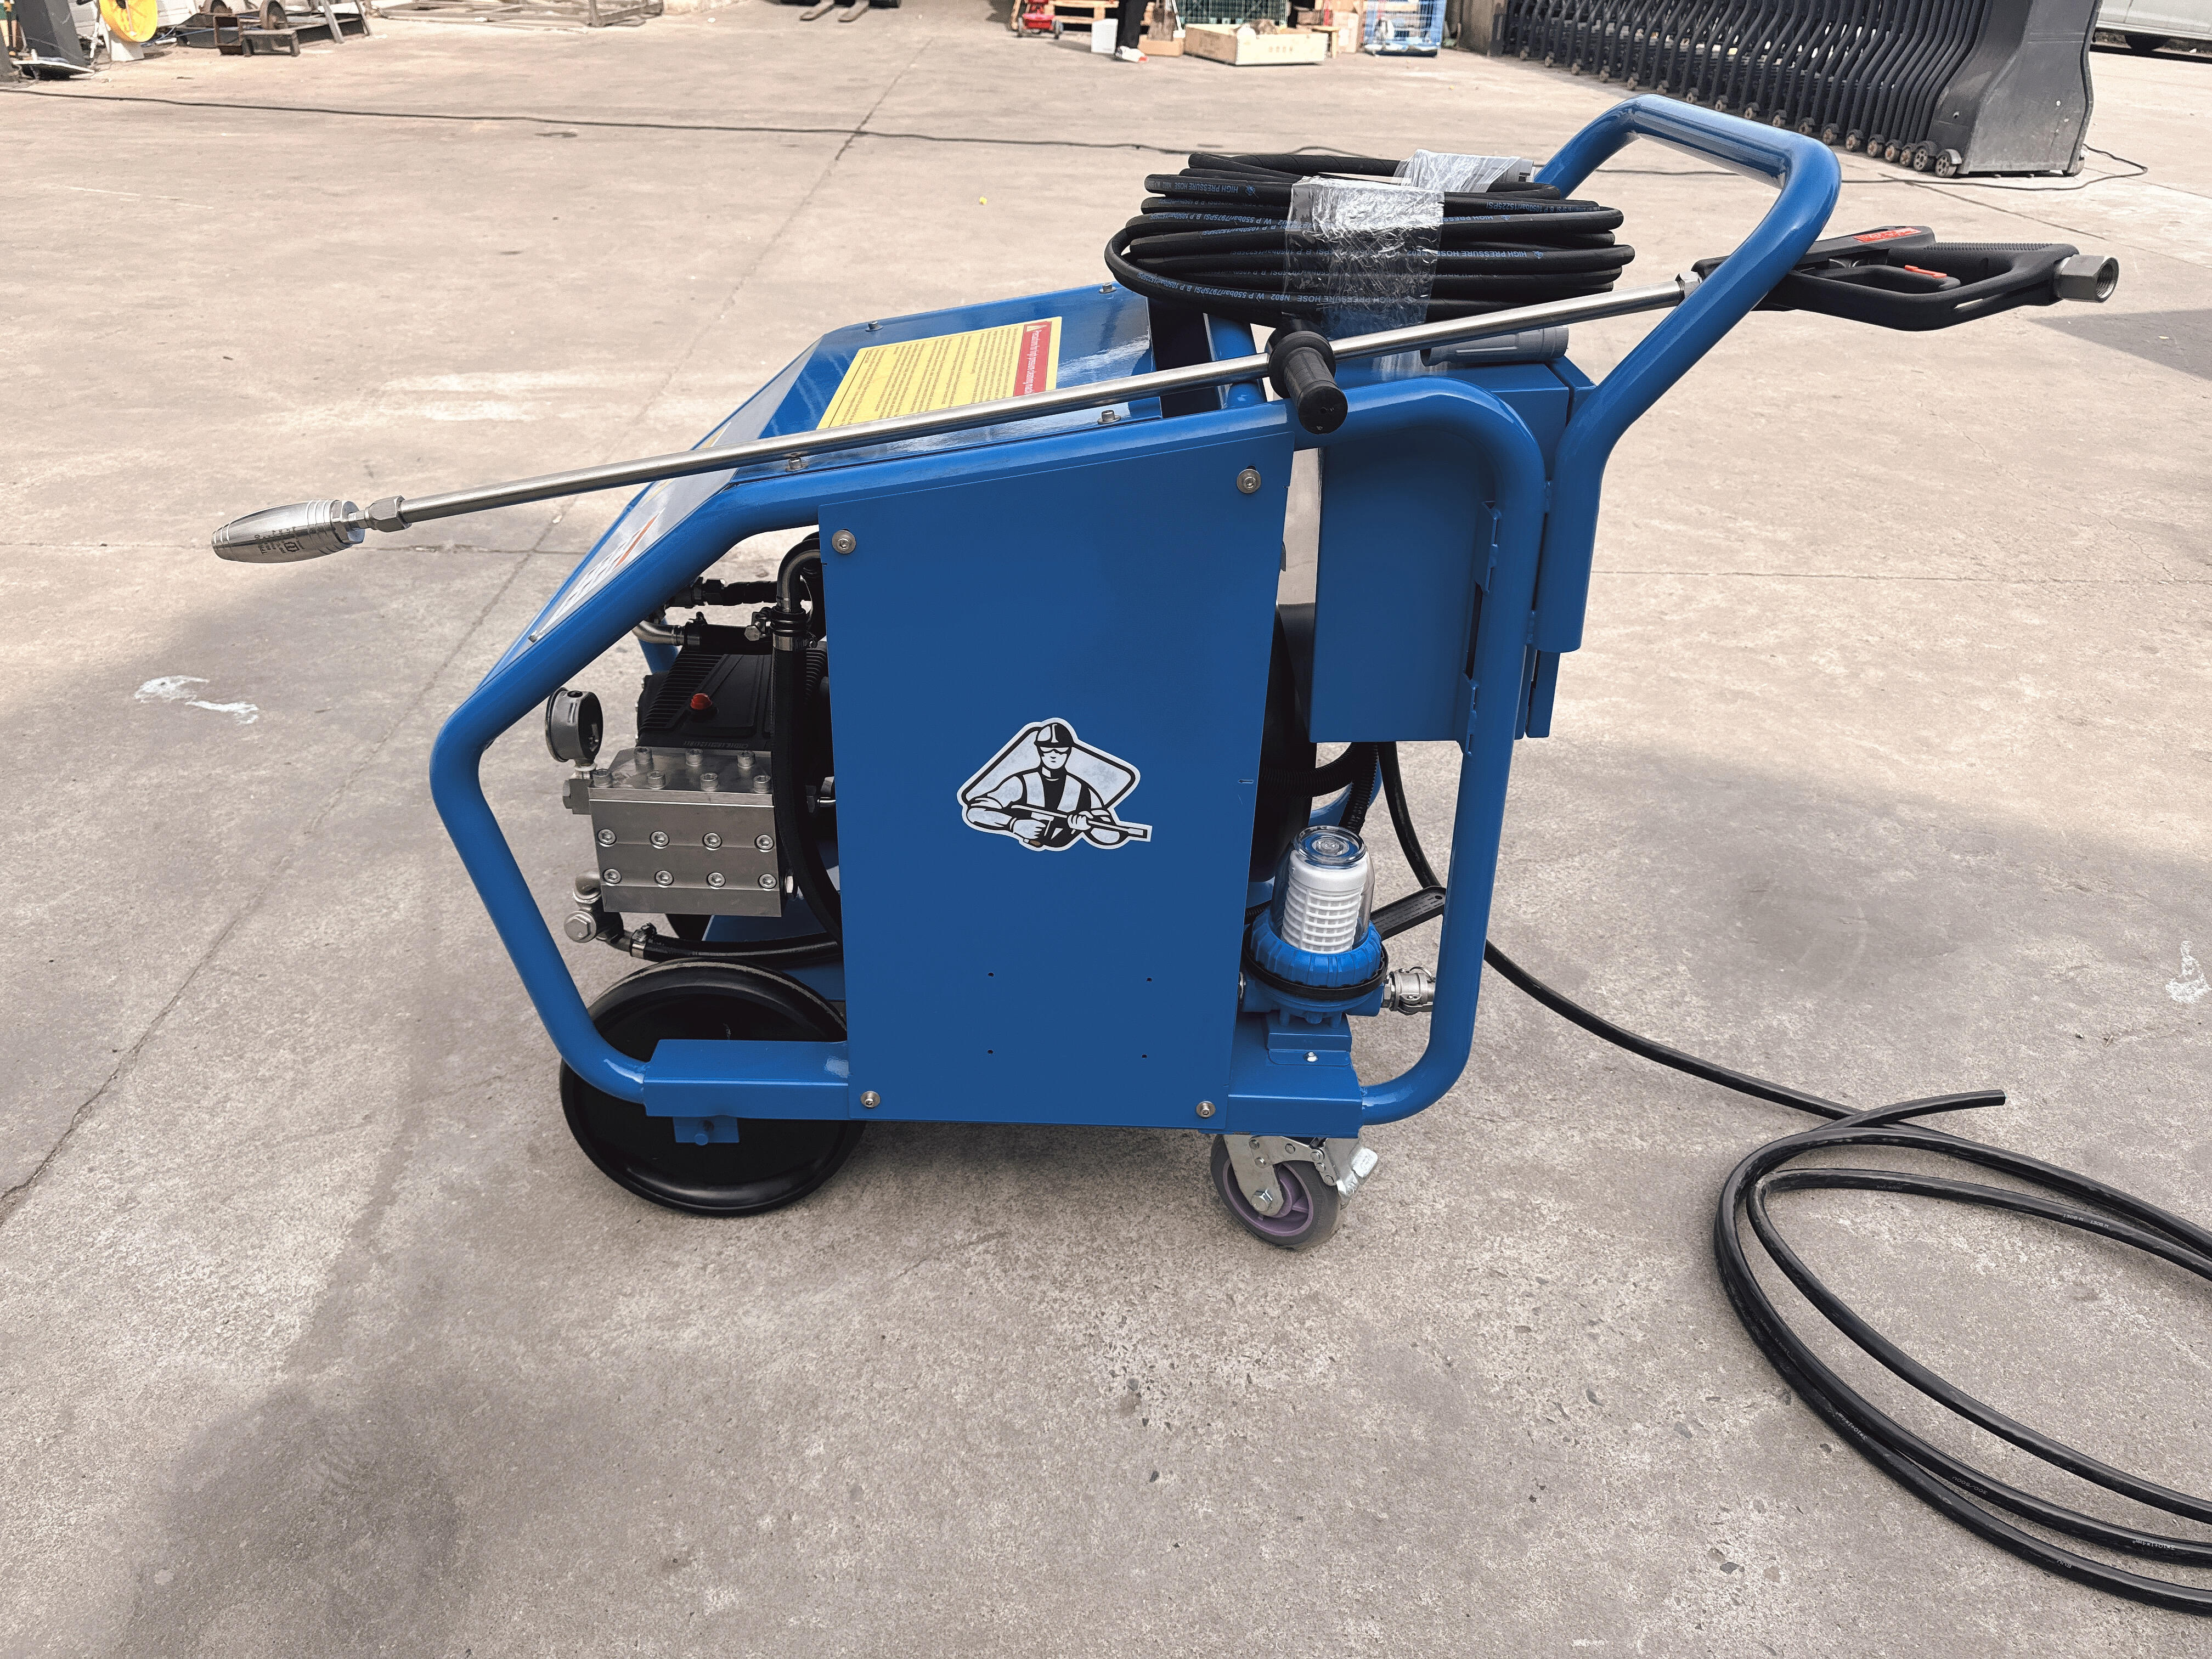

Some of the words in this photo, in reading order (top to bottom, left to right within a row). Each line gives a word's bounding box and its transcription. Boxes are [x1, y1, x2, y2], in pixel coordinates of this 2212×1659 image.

[1175, 182, 1188, 190] HOSE
[1188, 183, 1221, 193] PRESSURE
[1221, 185, 1239, 194] HIGH
[1203, 213, 1255, 224] 550bar/7975PSI
[1193, 286, 1248, 298] 550bar/7975PSI
[1270, 294, 1291, 302] N802
[1952, 1476, 1988, 1494] 300/500V
